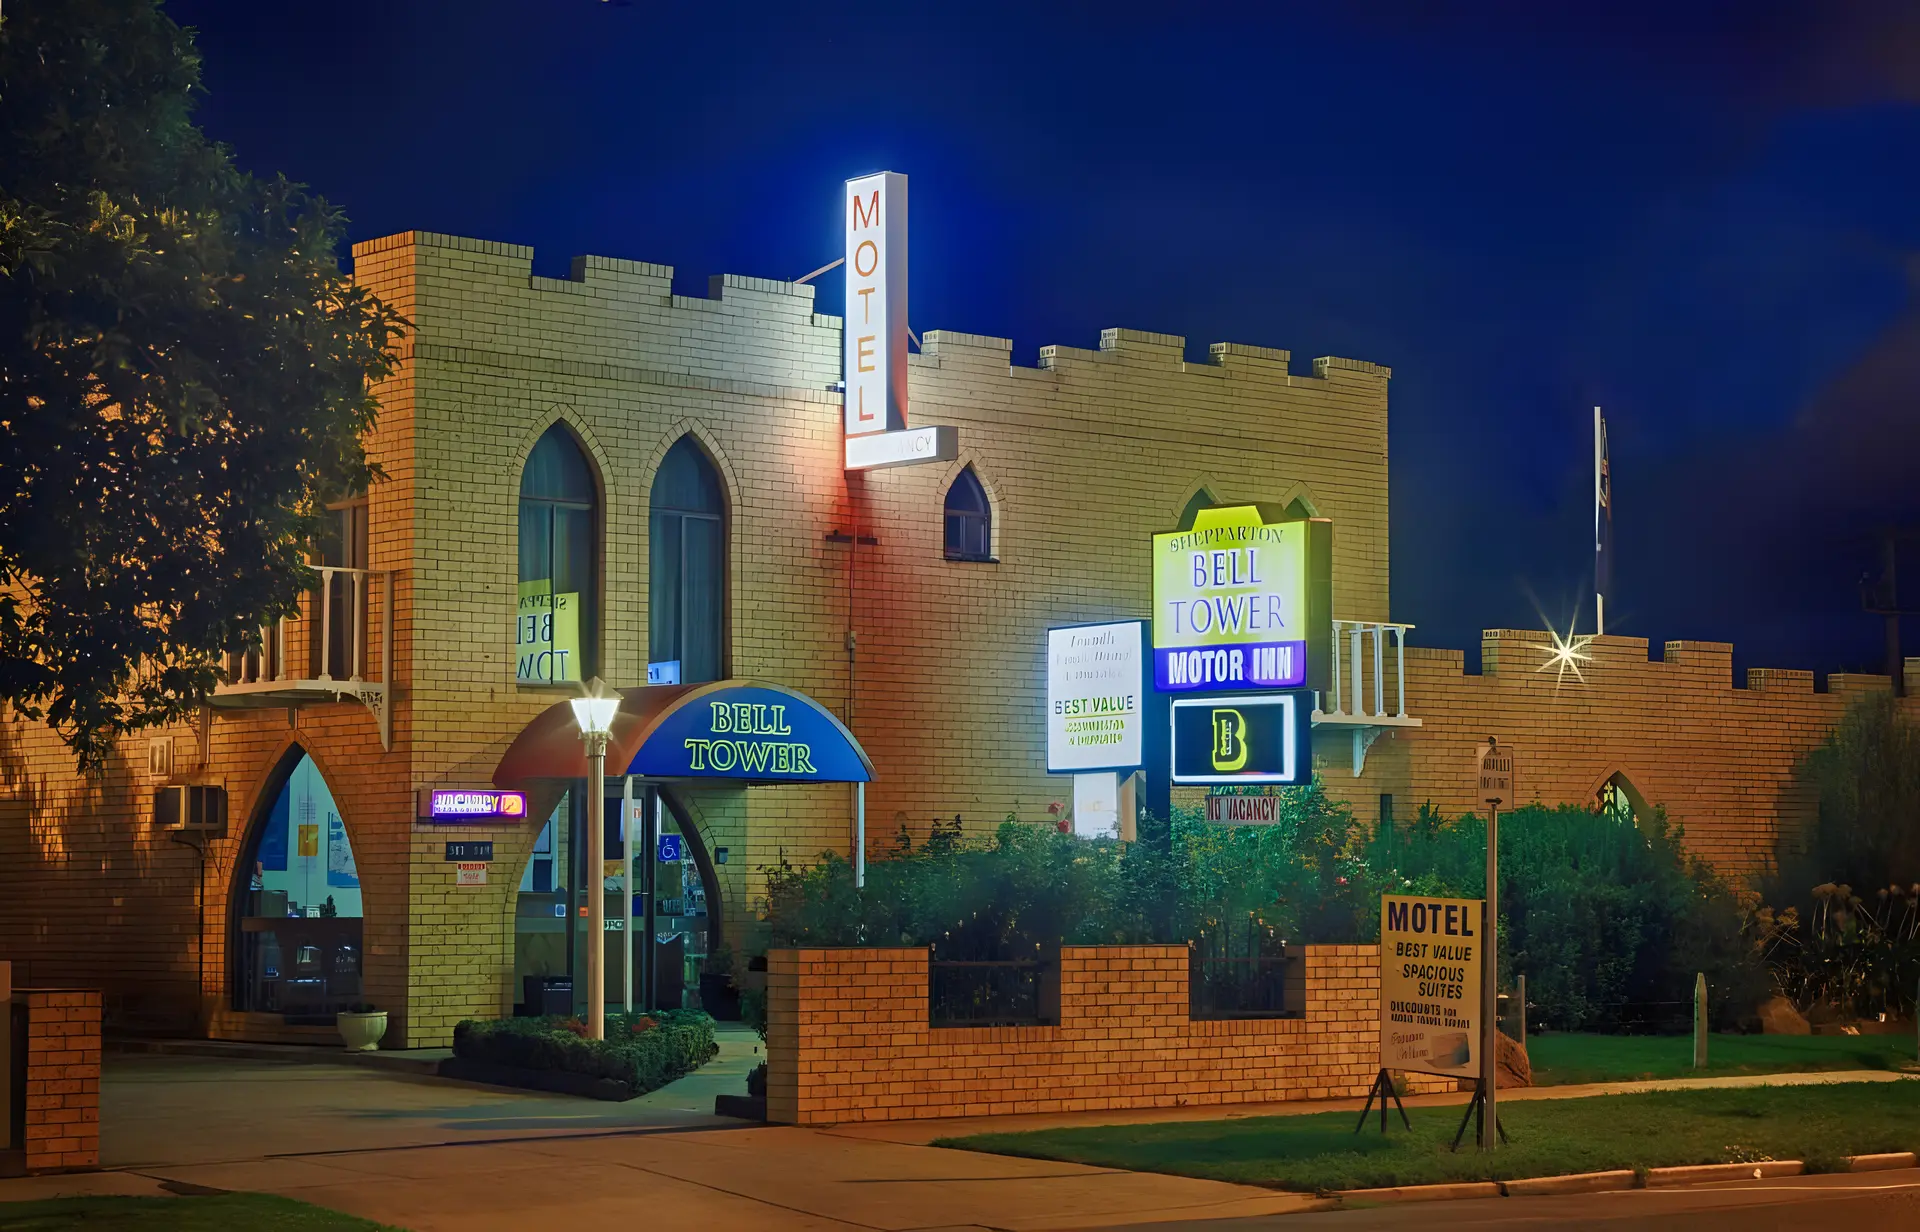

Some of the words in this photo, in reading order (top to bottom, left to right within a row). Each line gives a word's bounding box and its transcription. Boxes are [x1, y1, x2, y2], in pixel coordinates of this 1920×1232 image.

[853, 190, 879, 421] MOTEL
[1170, 526, 1284, 552] SHEPPARTON
[1193, 549, 1262, 588] BELL
[1169, 595, 1285, 634] TOWER
[1168, 649, 1244, 685] MOTOR
[1253, 646, 1293, 681] INN
[710, 701, 792, 735] BELL
[1055, 698, 1088, 715] BEST
[1092, 694, 1134, 713] VALUE
[684, 738, 818, 774] TOWER
[1227, 798, 1277, 821] VACANCY
[1388, 901, 1474, 937] MOTEL
[1396, 941, 1428, 958] BEST
[1433, 944, 1472, 962] VALUE
[1402, 963, 1465, 982] SPACIOUS
[1418, 982, 1463, 1000] SUITES
